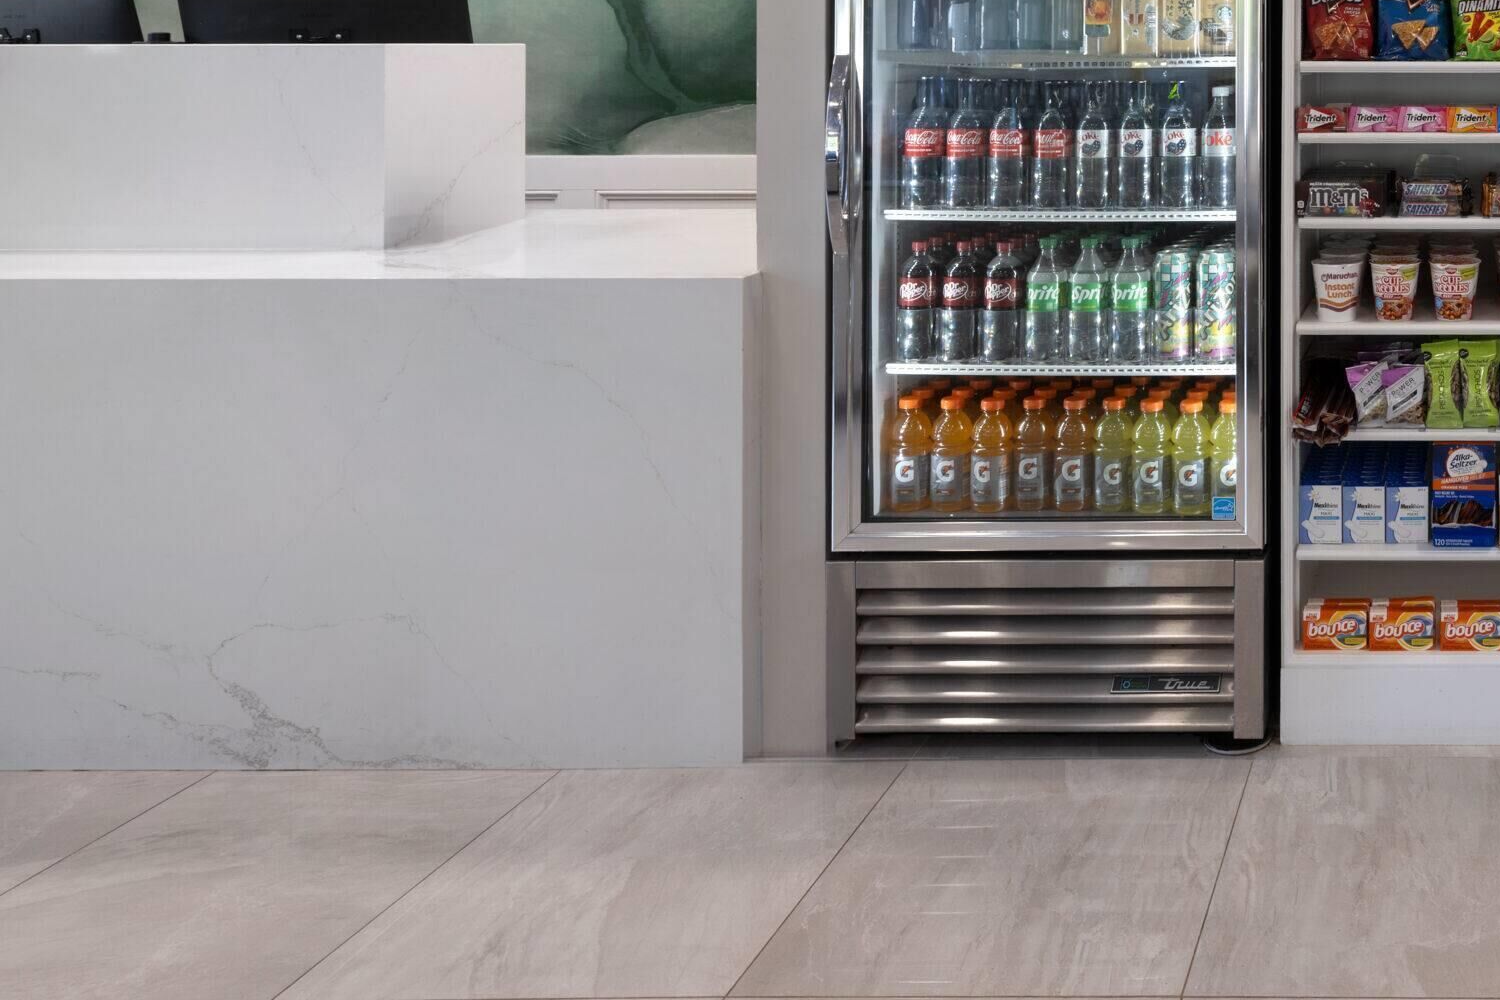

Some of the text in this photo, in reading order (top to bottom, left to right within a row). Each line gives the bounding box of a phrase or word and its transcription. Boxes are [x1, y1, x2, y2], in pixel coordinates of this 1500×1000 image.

[1306, 113, 1337, 123] Trident
[1357, 113, 1387, 122] Trident
[1407, 113, 1437, 122] Trident
[1456, 113, 1487, 122] Trident
[905, 131, 938, 145] Coca-Cola
[947, 131, 982, 145] Coca-Cola
[990, 131, 1022, 145] Coca-Cola
[1406, 184, 1449, 196] SATISFIES
[1406, 204, 1447, 216] SATISFIES
[1327, 272, 1359, 280] Maruchan
[1381, 276, 1404, 285] CUP
[1440, 276, 1462, 285] CUP
[993, 283, 1002, 291] Dr
[1325, 283, 1356, 291] Instant
[1376, 283, 1411, 294] NOODLES
[1435, 283, 1470, 294] NOODLES
[1327, 290, 1353, 299] Lunch
[1019, 458, 1038, 480] G
[1062, 459, 1081, 482] G
[1450, 459, 1477, 469] Seltzer
[895, 460, 915, 483] G
[937, 460, 955, 483] G
[974, 461, 991, 483] G
[1104, 464, 1122, 485] G
[1140, 461, 1159, 484] G
[1179, 465, 1198, 487] G
[1220, 464, 1237, 487] G
[1309, 620, 1356, 636] bounce
[1375, 621, 1420, 637] bounce
[1447, 621, 1494, 637] bounce
